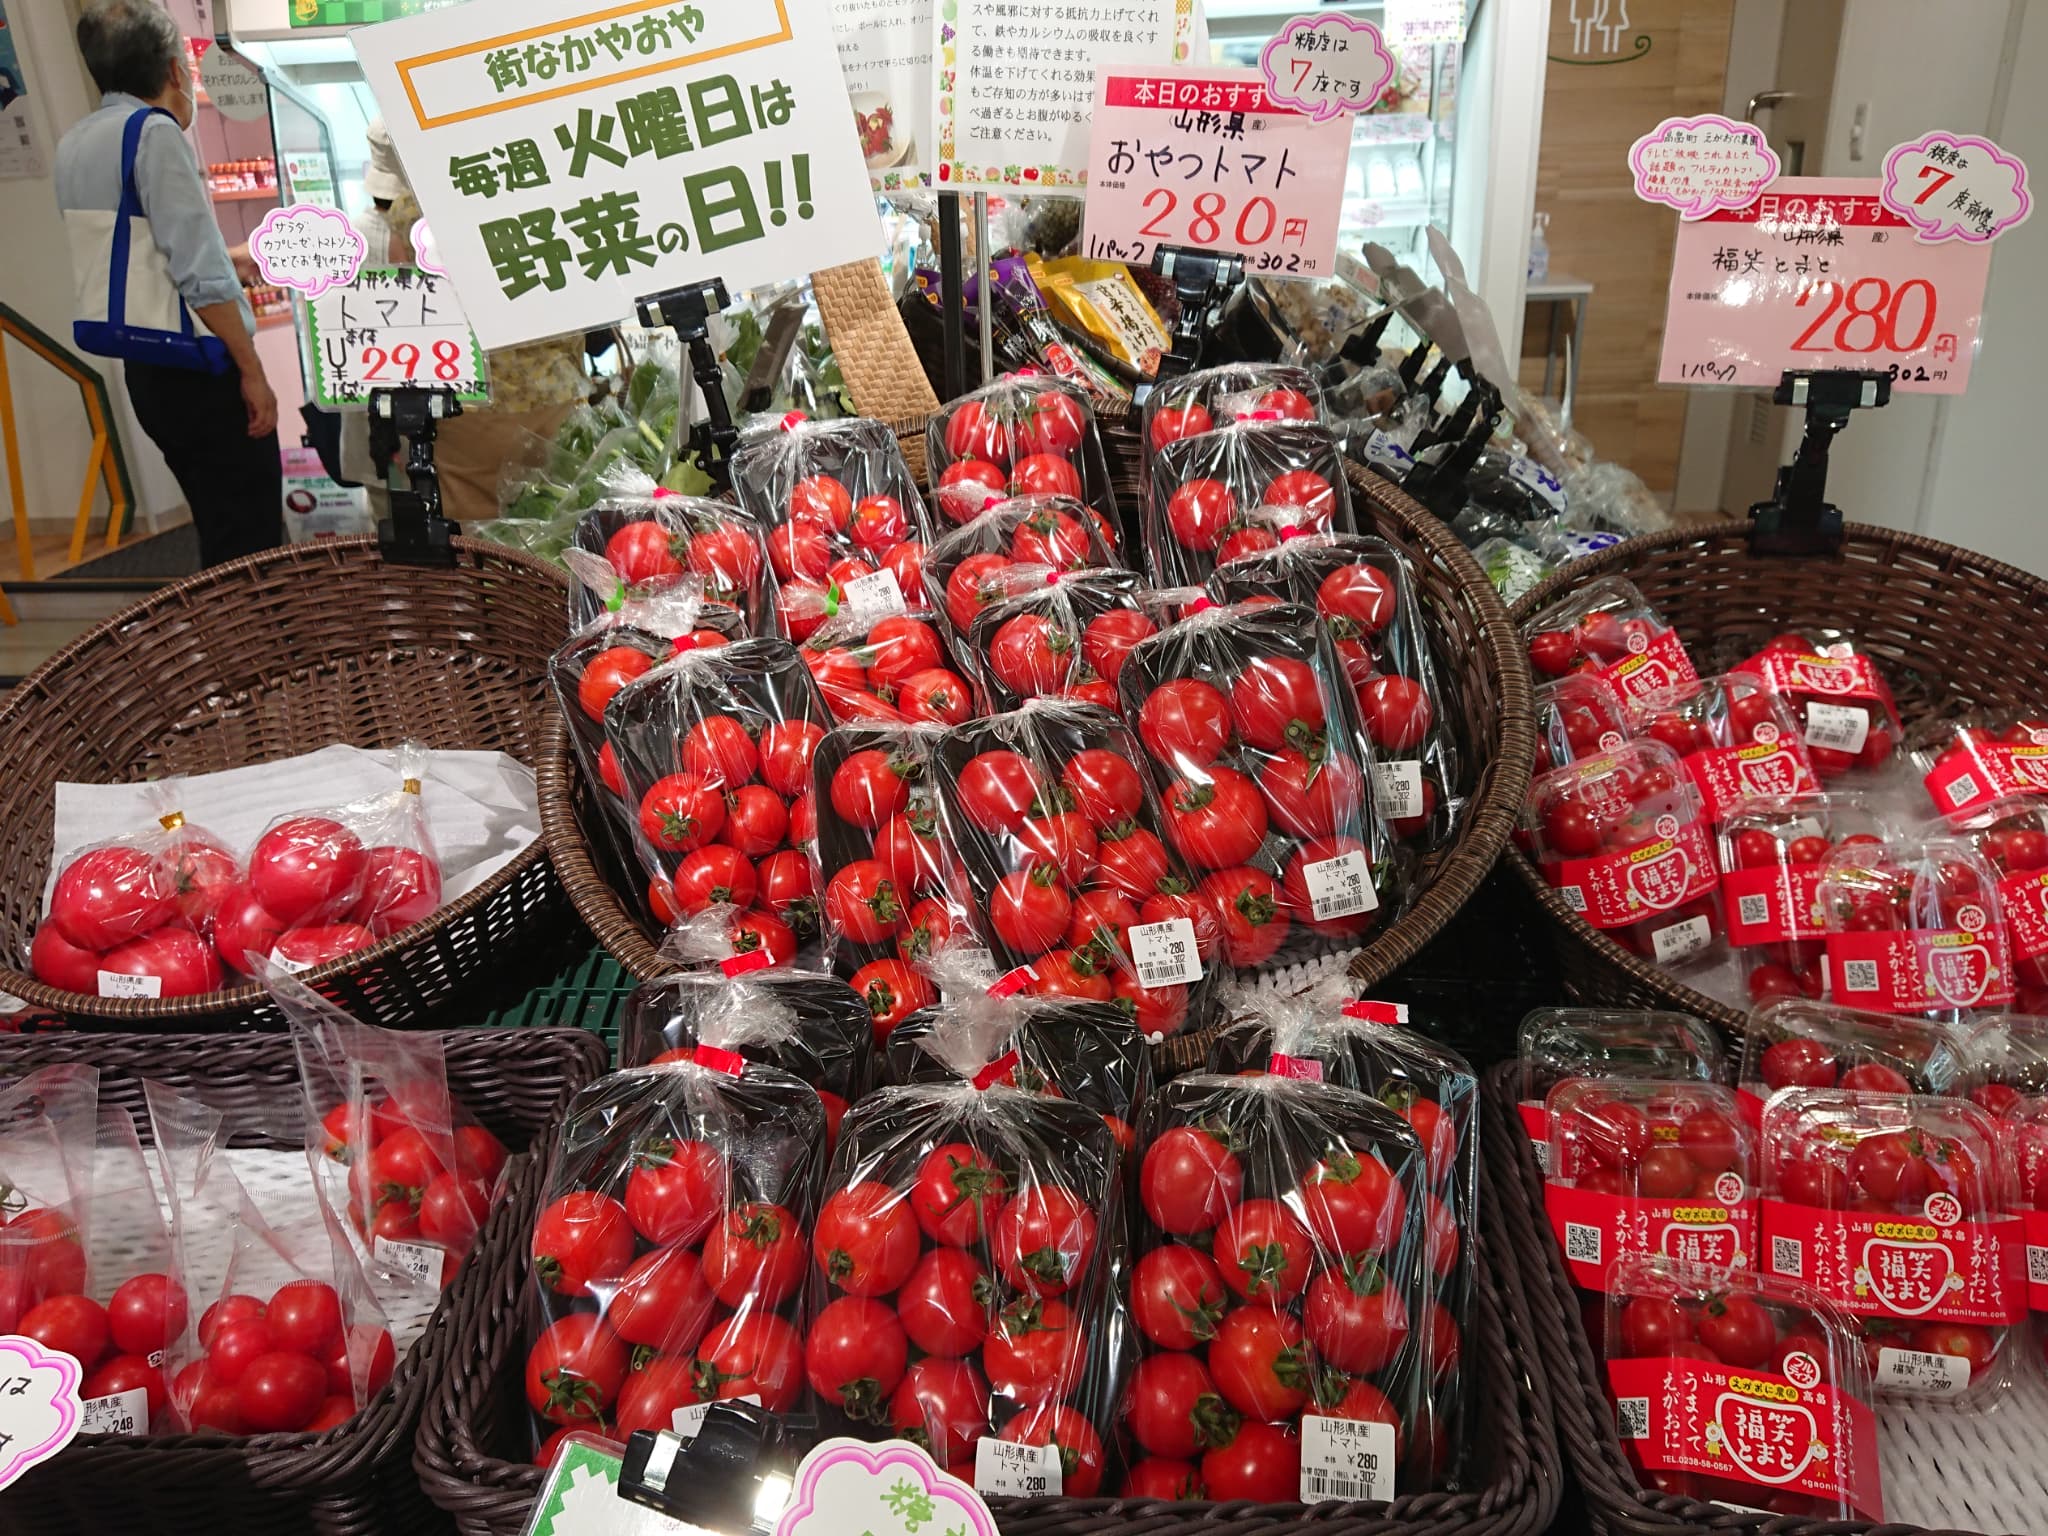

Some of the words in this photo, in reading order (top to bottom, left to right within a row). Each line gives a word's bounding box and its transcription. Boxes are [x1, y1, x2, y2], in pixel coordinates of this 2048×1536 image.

[484, 5, 705, 92] 街なかやおや
[1295, 31, 1349, 52] 糖度は
[969, 127, 1052, 141] ご注意ください。
[1107, 139, 1297, 190] おやつトマト
[332, 270, 350, 280] ませ
[341, 294, 437, 329] トマト
[1680, 363, 1737, 380] 1パック
[1640, 858, 1678, 887] 福笑
[1645, 879, 1682, 902] とまと
[1851, 1222, 1872, 1233] 山形
[1677, 1233, 1724, 1261] 福笑
[1813, 1222, 1832, 1293] えがおに
[1834, 1223, 1850, 1295] うまくて
[1880, 1251, 1934, 1280] 福笑
[1969, 1237, 1988, 1304] えがおに
[1882, 1279, 1932, 1301] とまと
[1937, 1307, 2006, 1319] egaonifarm.com
[1702, 1372, 1726, 1386] 山形
[1663, 1371, 1680, 1449] えがおに
[1684, 1372, 1702, 1452] うまくて
[1321, 1419, 1370, 1438] 山形県産
[1735, 1406, 1796, 1443] 福笑
[993, 1443, 1038, 1463] 山形県産
[1330, 1435, 1361, 1450] トマト
[1347, 1453, 1378, 1470] ¥280
[1737, 1439, 1795, 1470] とまと
[1001, 1460, 1030, 1474] トマト
[1017, 1476, 1046, 1491] ¥280
